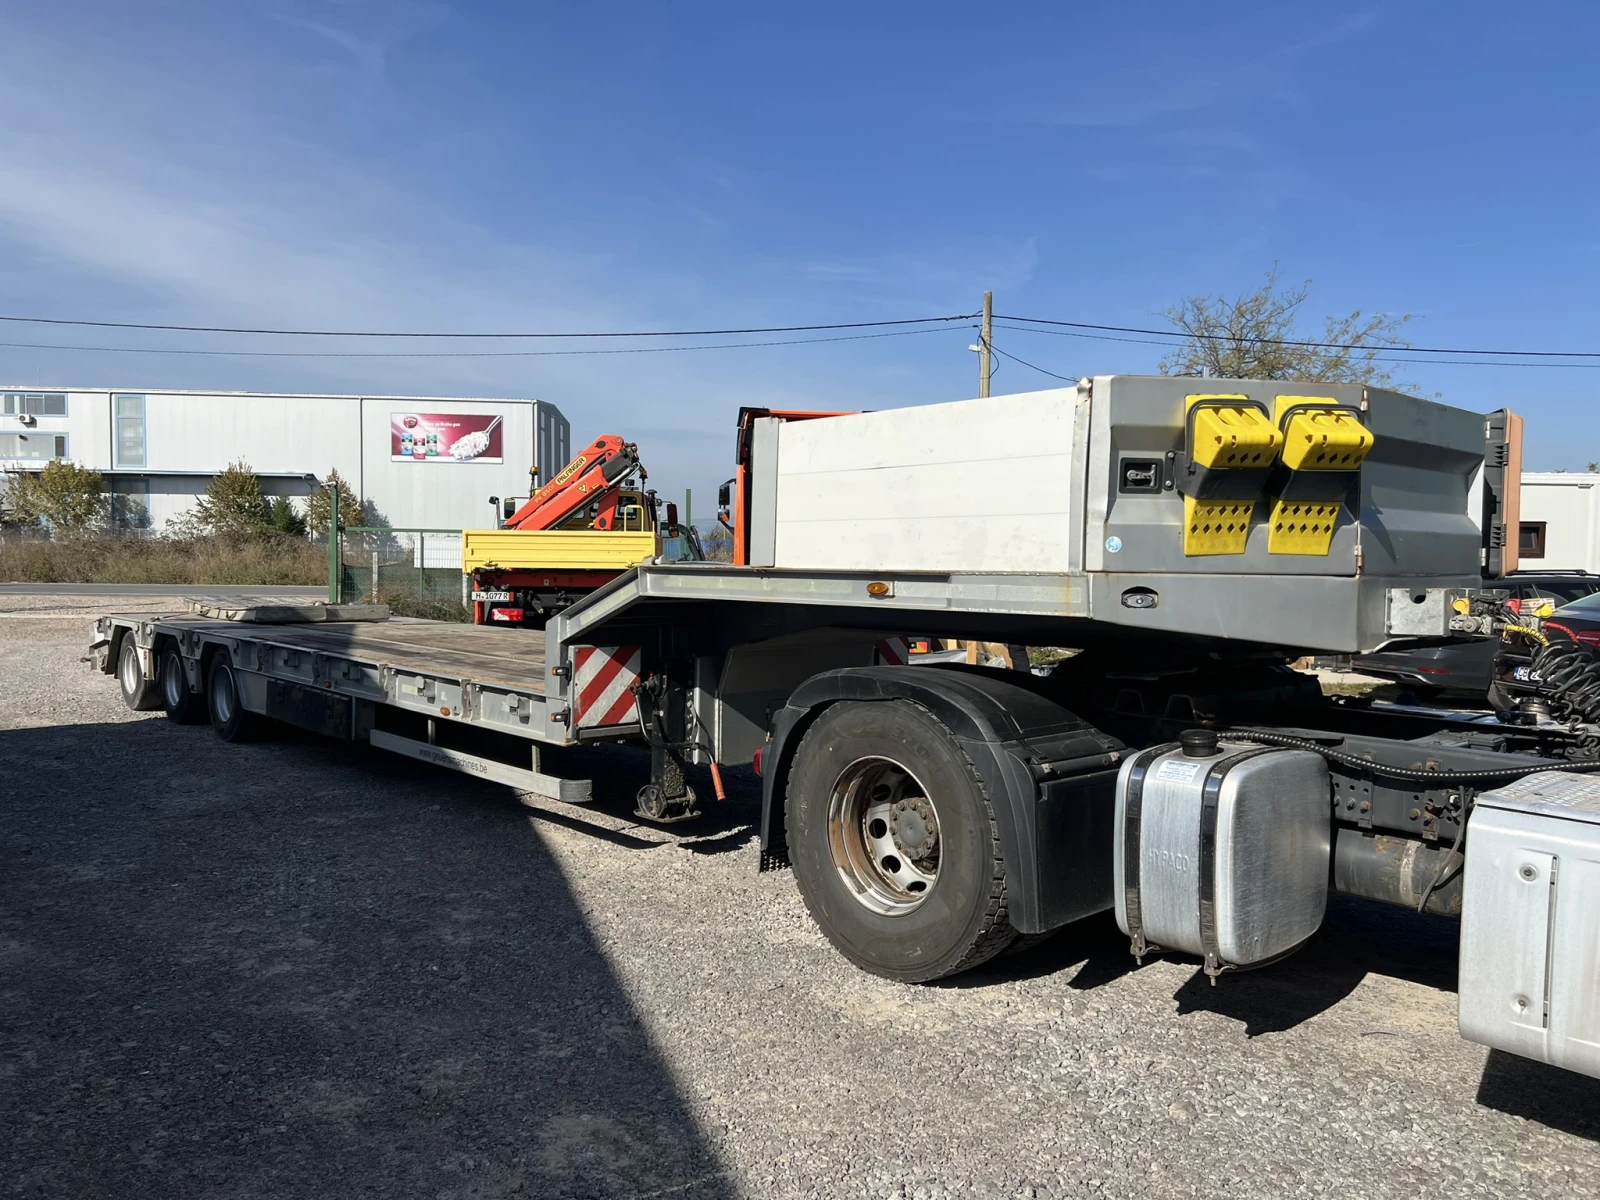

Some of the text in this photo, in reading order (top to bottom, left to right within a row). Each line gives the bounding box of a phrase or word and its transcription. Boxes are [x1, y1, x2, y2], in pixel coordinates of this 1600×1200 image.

[556, 457, 585, 484] PALFINGER
[534, 495, 543, 503] PK
[475, 592, 481, 600] H
[485, 592, 502, 600] 1077
[1148, 848, 1190, 873] HYPACO
